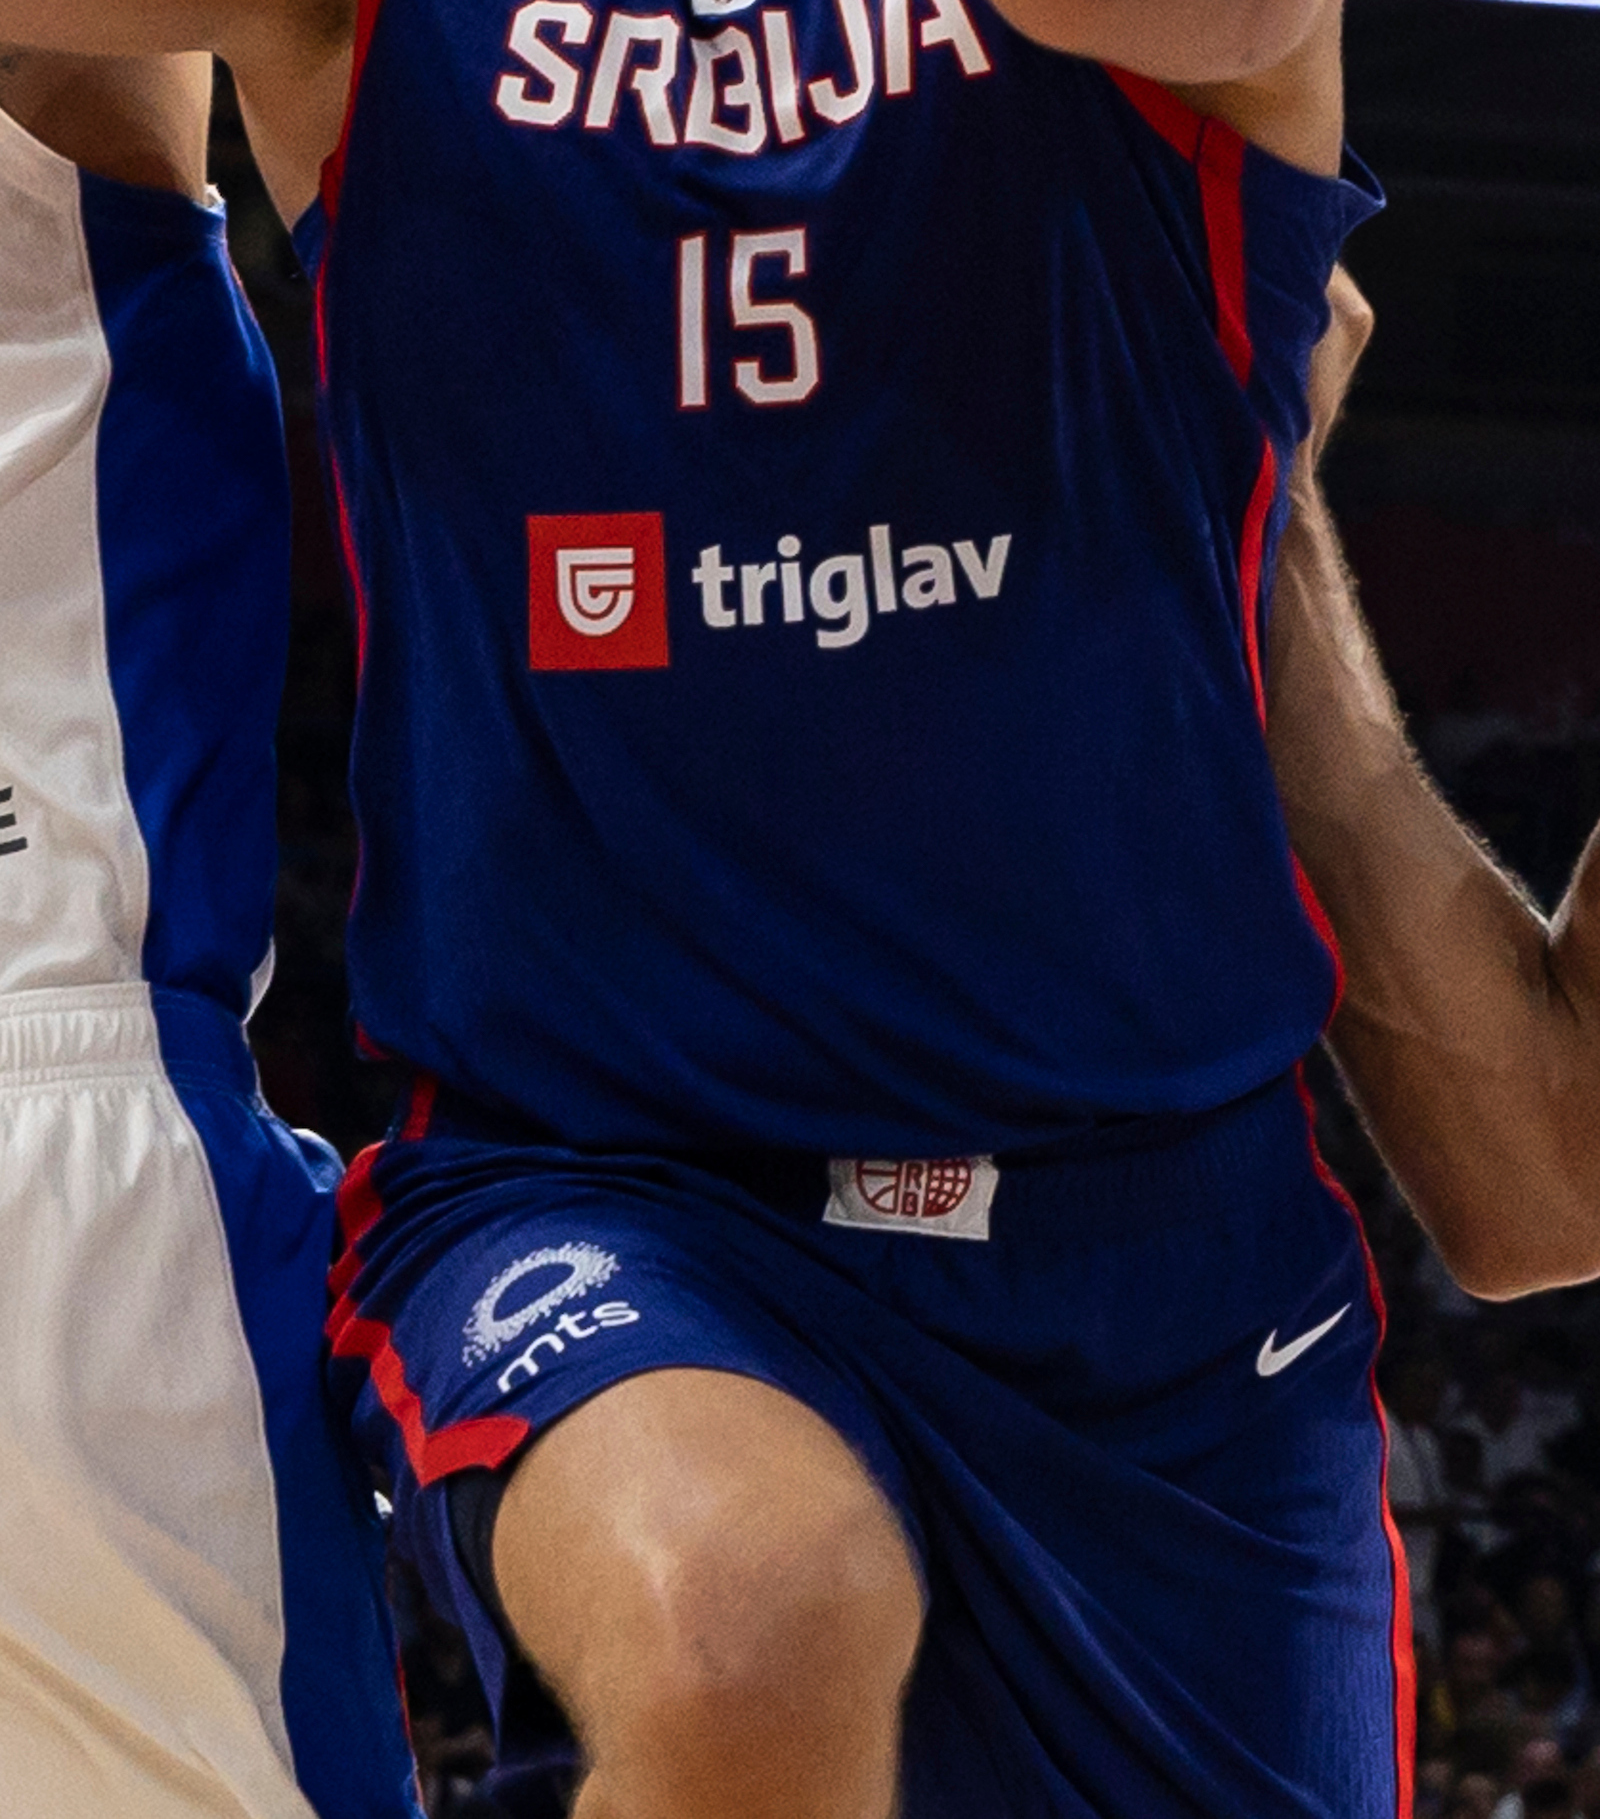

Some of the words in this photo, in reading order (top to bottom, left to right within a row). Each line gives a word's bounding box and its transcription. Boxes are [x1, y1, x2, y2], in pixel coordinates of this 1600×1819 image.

[676, 224, 821, 410] 15
[691, 524, 1012, 649] triglav
[496, 1300, 641, 1394] mts
